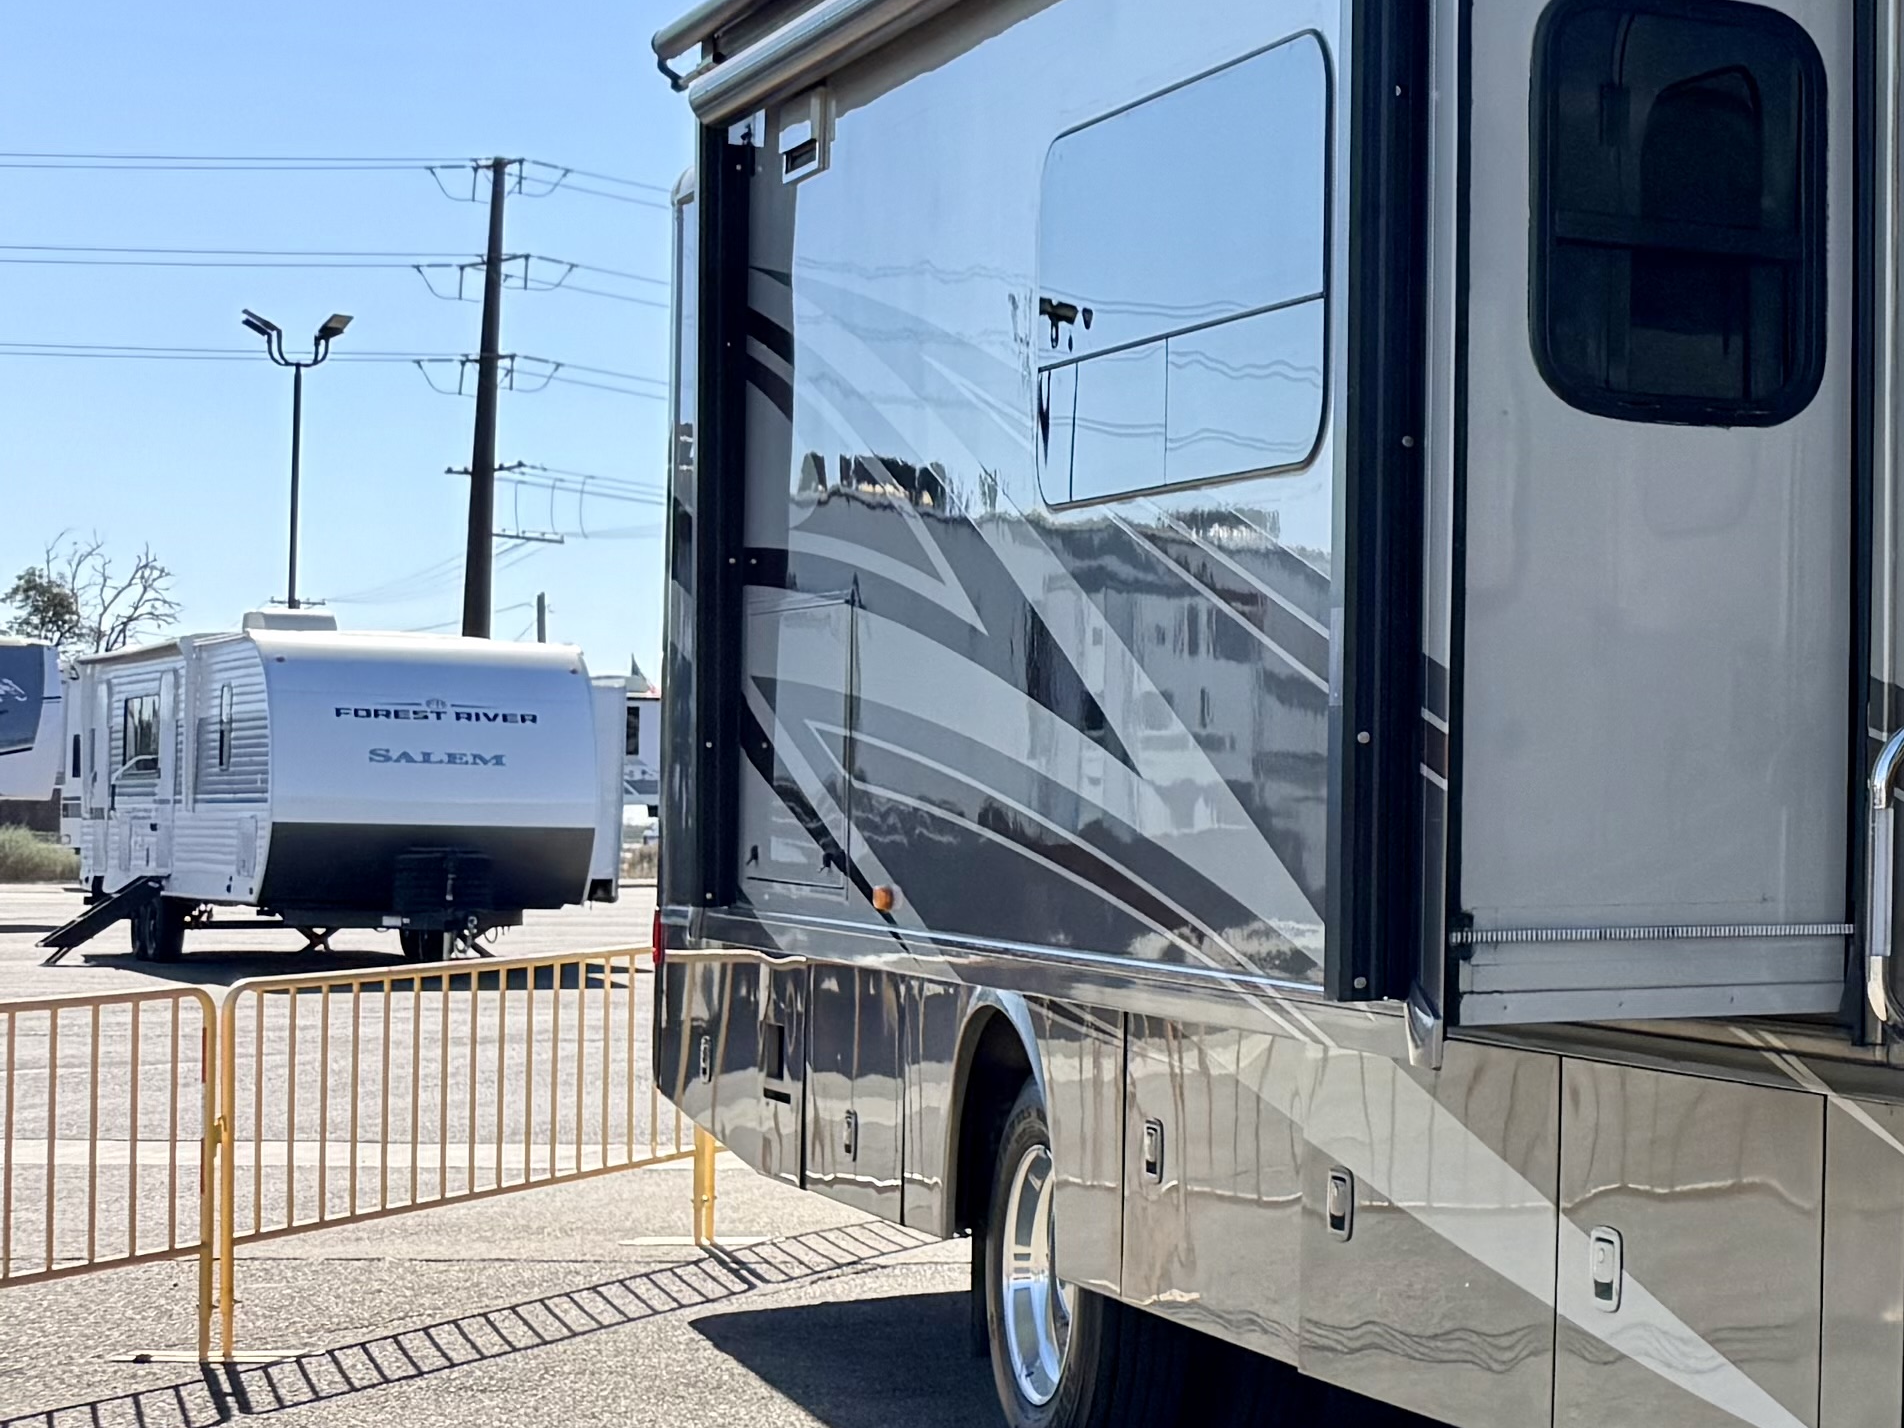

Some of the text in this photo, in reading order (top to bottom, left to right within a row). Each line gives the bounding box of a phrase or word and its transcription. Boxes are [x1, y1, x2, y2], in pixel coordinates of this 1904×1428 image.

[335, 707, 538, 724] FOREST RIVER
[368, 748, 506, 766] SALEM
